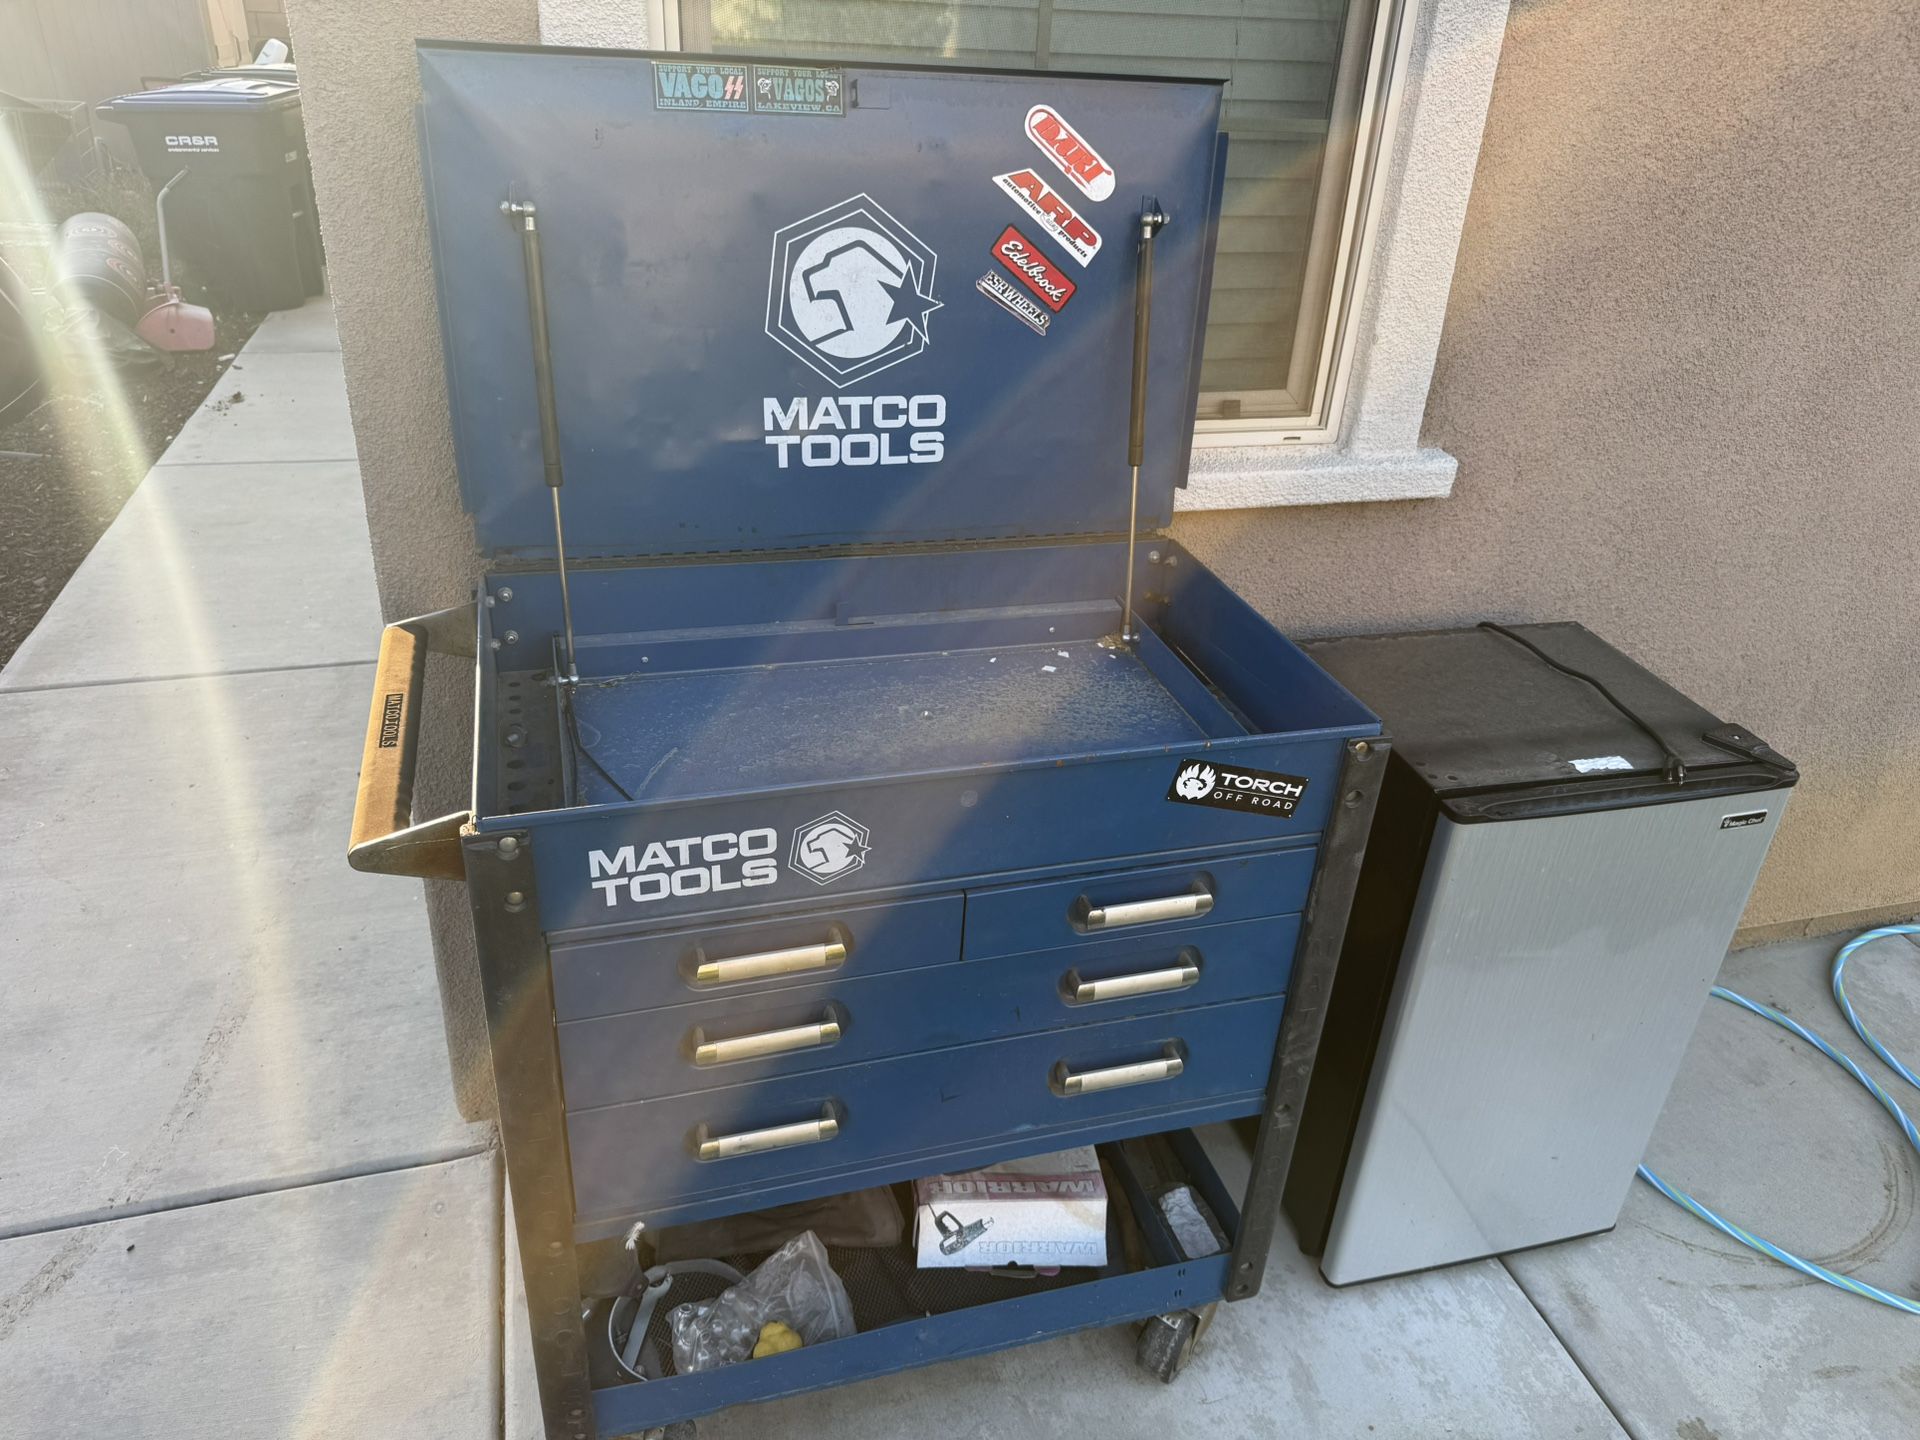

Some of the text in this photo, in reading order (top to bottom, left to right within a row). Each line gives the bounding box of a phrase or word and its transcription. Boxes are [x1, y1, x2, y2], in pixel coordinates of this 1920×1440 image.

[658, 65, 743, 75] SUPPORT YOUR LOCAL
[757, 68, 789, 77] SUPPORT
[793, 69, 812, 78] YOUR
[706, 100, 746, 109] EMPIRE
[773, 77, 825, 102] VAGOS
[165, 135, 219, 146] CR&R
[1033, 114, 1108, 184] DART
[1002, 178, 1042, 215] automotive
[1057, 230, 1087, 258] products
[1007, 171, 1097, 247] ARP
[1001, 240, 1067, 302] Edelbrock
[984, 271, 1049, 326] ESR WHEELS
[763, 394, 947, 431] MATCO
[765, 431, 945, 469] TOOLS
[1221, 772, 1304, 798] TORCH
[1213, 791, 1294, 811] OFF ROAD
[588, 827, 778, 878] MATCO
[592, 857, 778, 907] TOOLS
[929, 1179, 1097, 1195] WARRIOR
[978, 1240, 1099, 1256] WARRIOR
